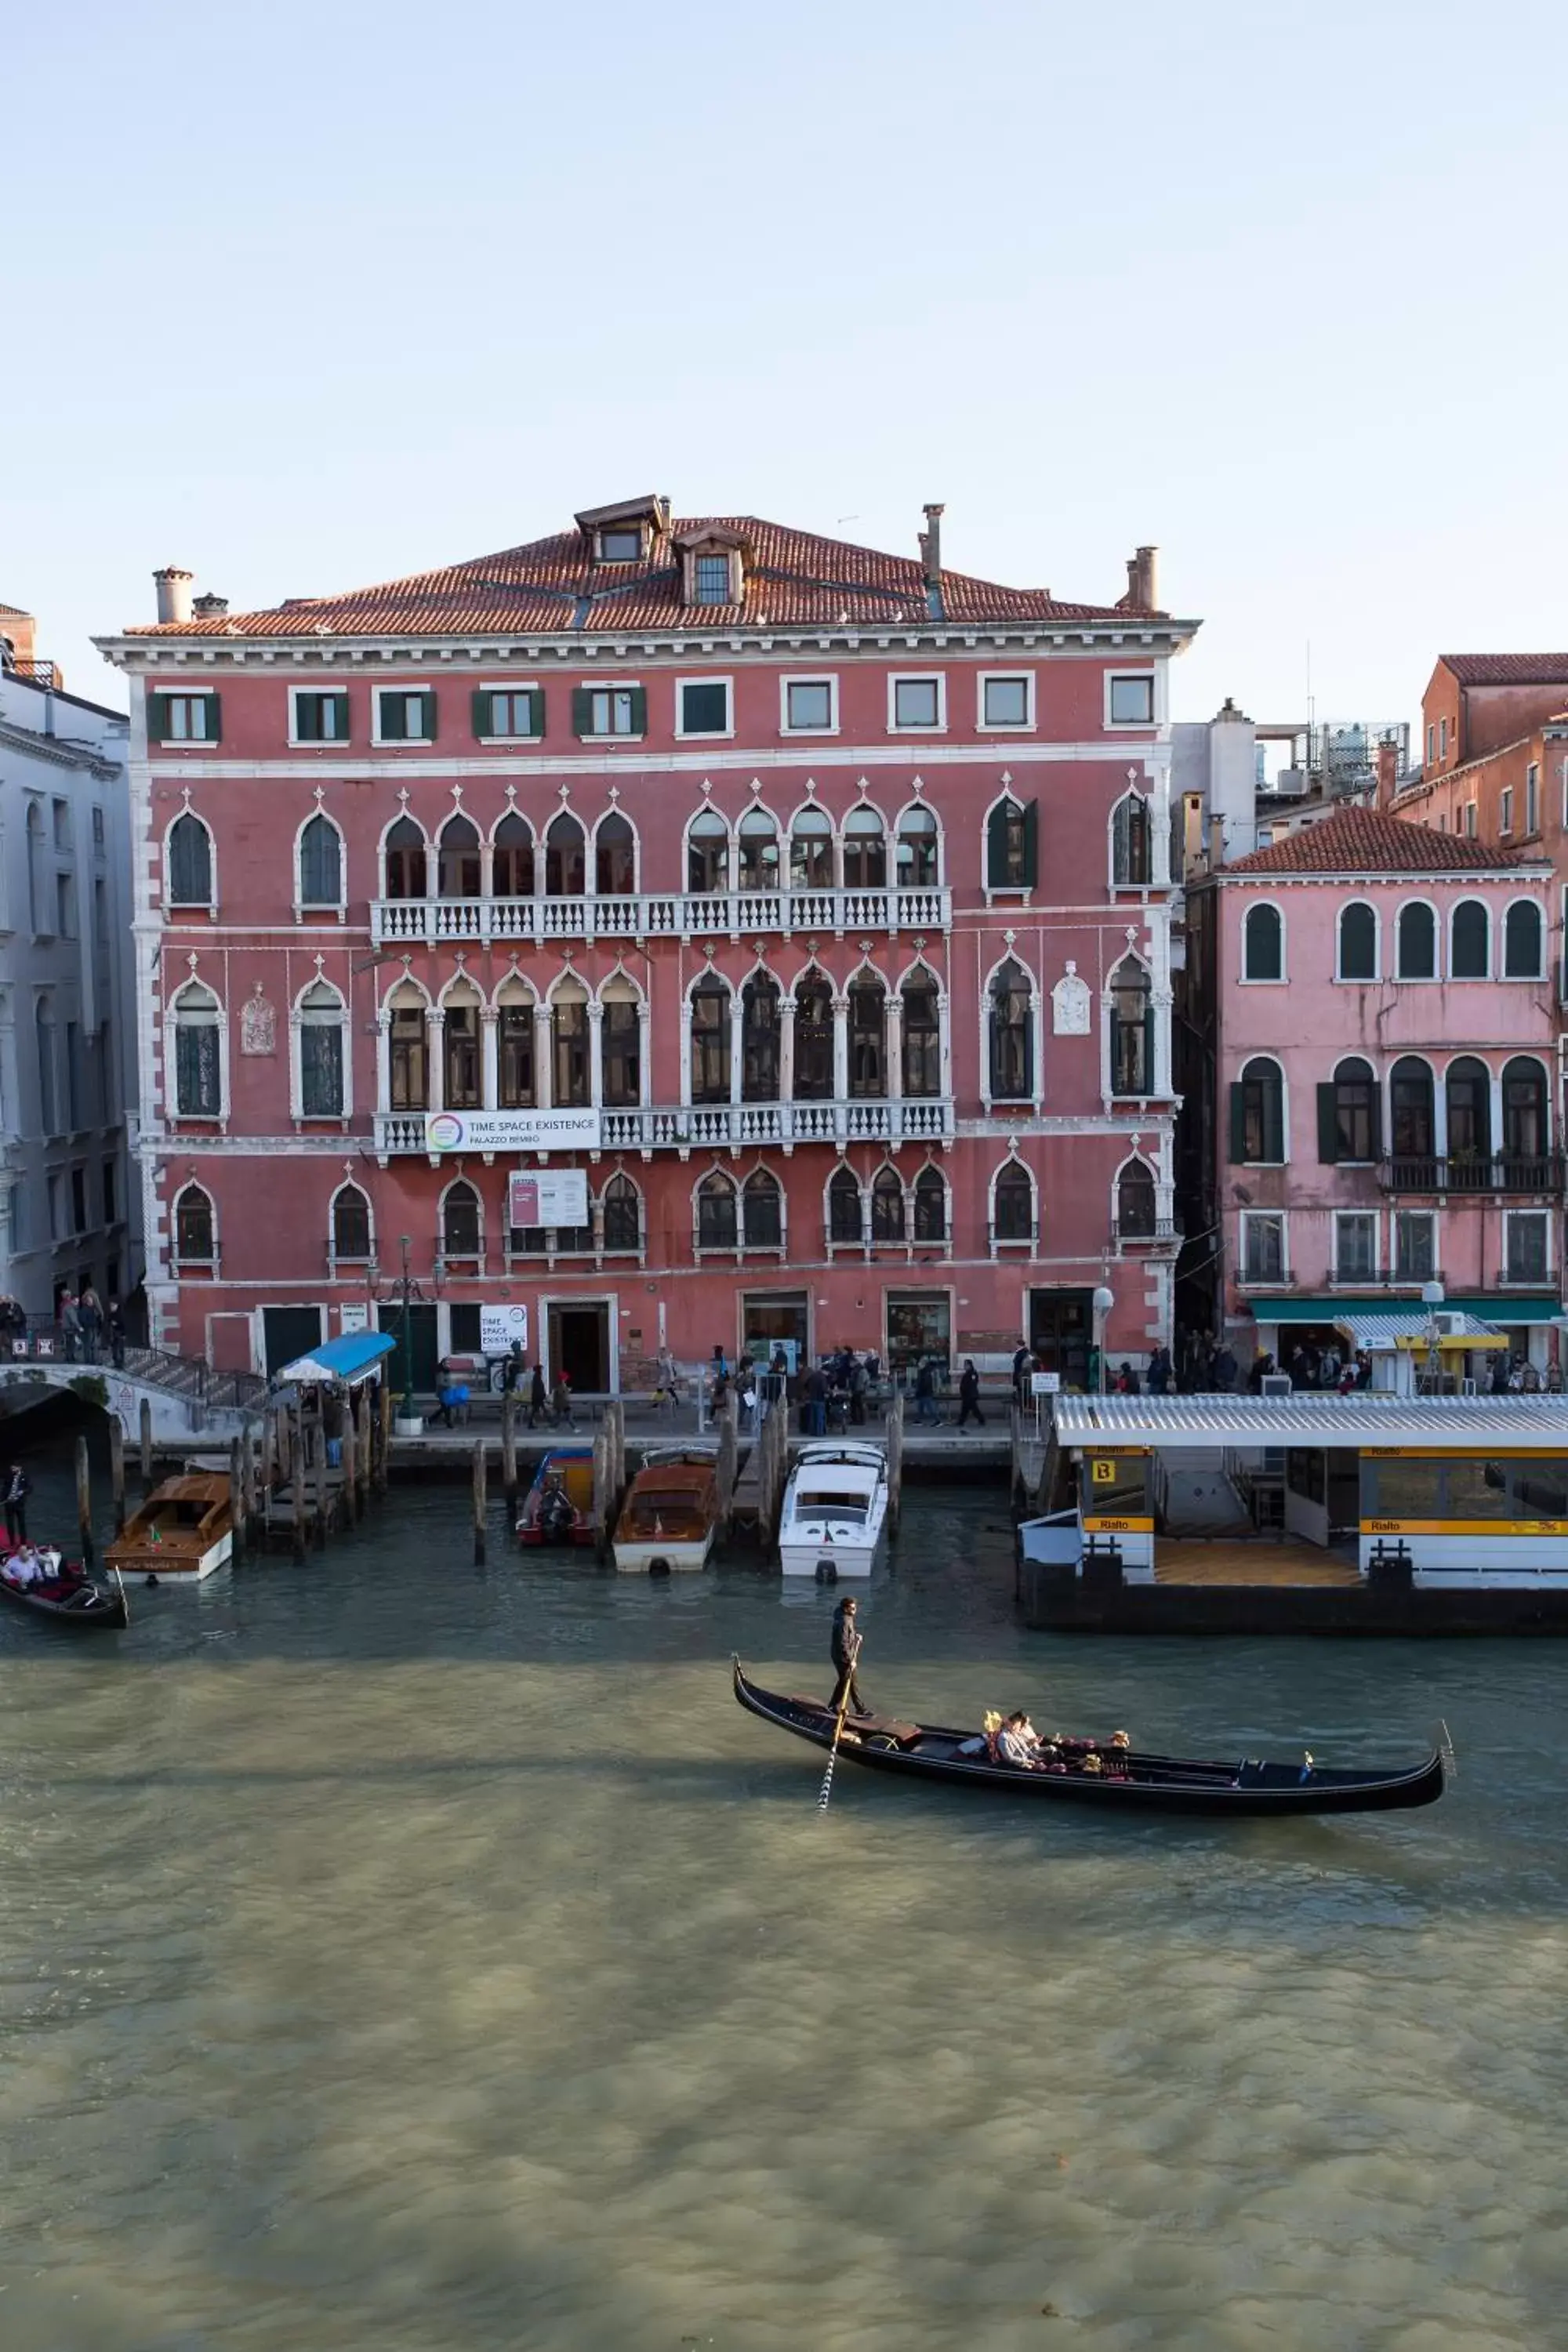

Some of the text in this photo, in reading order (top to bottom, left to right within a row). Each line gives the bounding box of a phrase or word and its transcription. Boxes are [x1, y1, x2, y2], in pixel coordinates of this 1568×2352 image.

[470, 1120, 595, 1131] TIME SPACE EXISTENCE
[470, 1135, 539, 1145] PALAZZO BEMBO
[1098, 1463, 1110, 1479] B
[1101, 1519, 1129, 1530] Rialto
[1371, 1521, 1400, 1531] Rialto
